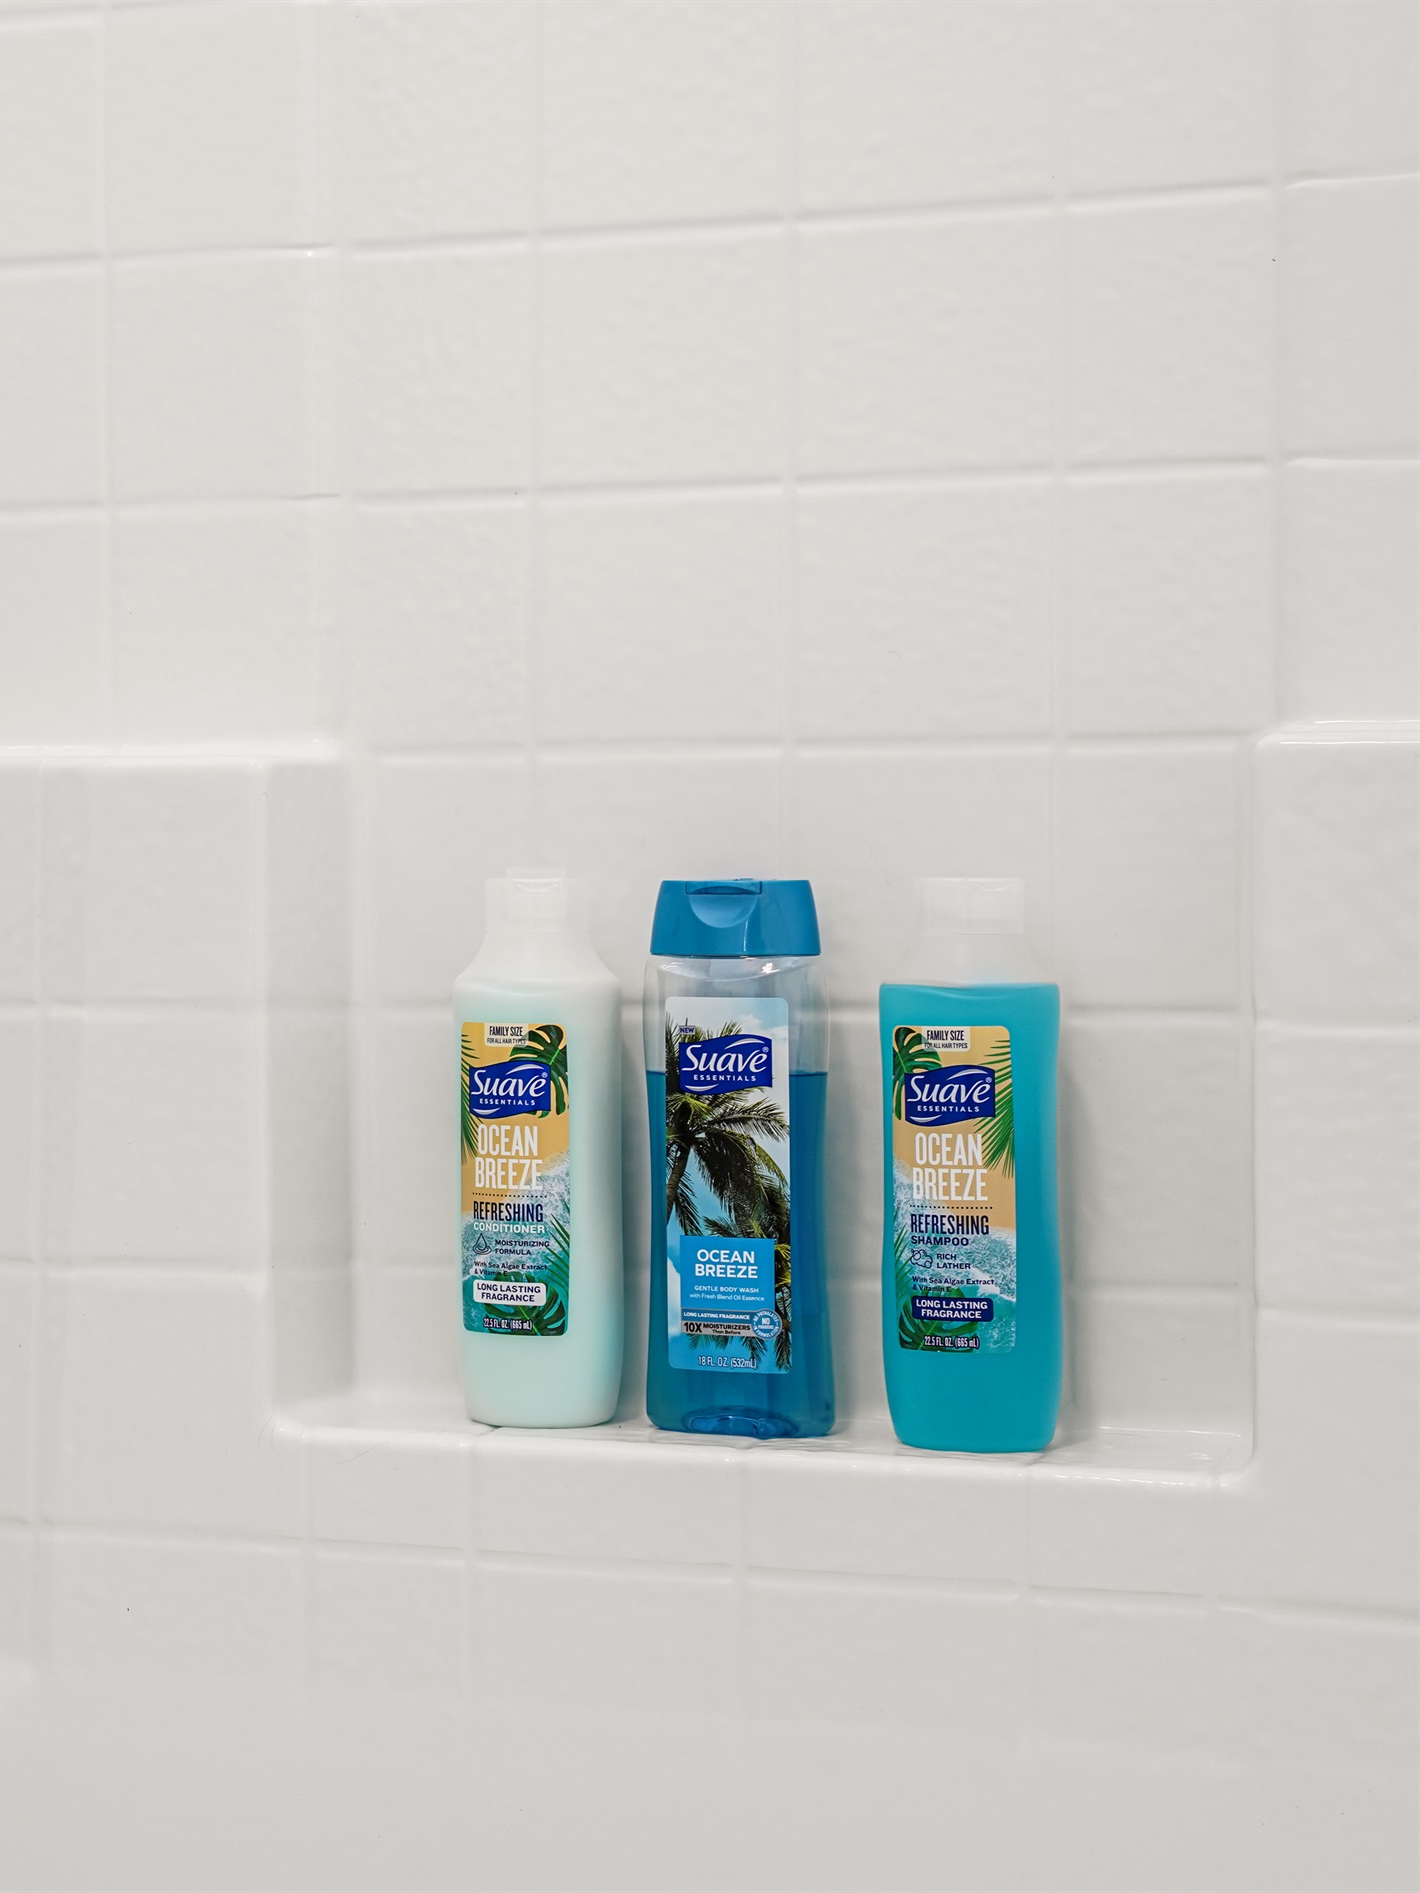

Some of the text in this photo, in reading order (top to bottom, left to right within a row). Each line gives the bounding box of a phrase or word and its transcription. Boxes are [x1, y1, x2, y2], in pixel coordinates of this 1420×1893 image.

[490, 1026, 523, 1036] FAMILY SIZE
[927, 1030, 964, 1041] FAMILY SIZE
[478, 1124, 538, 1156] OCEAN
[915, 1132, 983, 1166] OCEAN
[475, 1157, 542, 1190] BREEZE
[912, 1167, 988, 1200] BREEZE
[473, 1201, 543, 1222] REFRESHING
[473, 1222, 545, 1234] CONDITIONER
[910, 1214, 989, 1235] REFRESHING
[911, 1236, 969, 1246] SHAMPOO
[697, 1249, 755, 1263] OCEAN
[501, 1263, 519, 1271] Algae
[695, 1264, 758, 1278] BREEZE
[477, 1283, 540, 1293] LONG LASTING
[481, 1292, 534, 1302] FRAGRANCE
[916, 1299, 988, 1309] LONG LASTING
[921, 1308, 982, 1318] FRAGRANCE
[484, 1318, 493, 1327] 22.5
[684, 1322, 702, 1333] 10X
[925, 1336, 935, 1346] 22.5
[698, 1357, 706, 1366] 18
[731, 1359, 756, 1368] (532mL)
